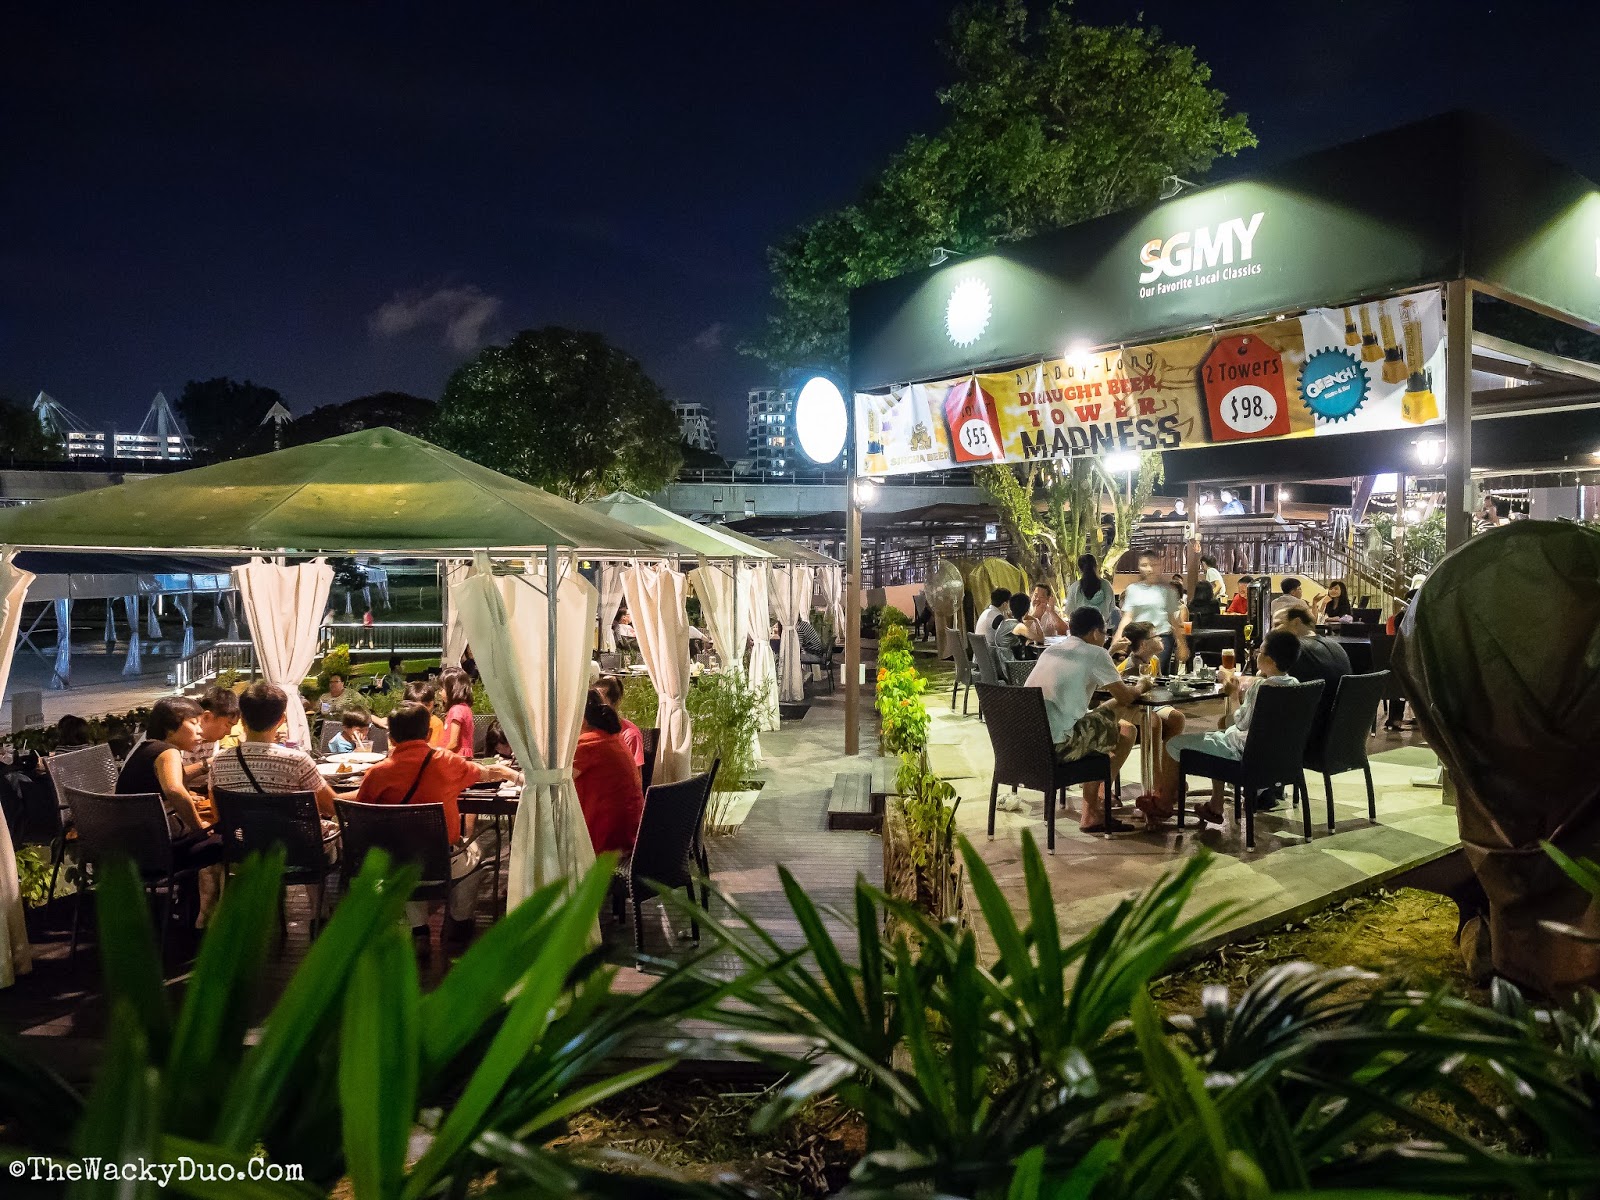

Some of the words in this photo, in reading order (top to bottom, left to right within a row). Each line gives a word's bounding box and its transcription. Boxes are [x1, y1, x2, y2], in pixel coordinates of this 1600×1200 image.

[1139, 212, 1265, 284] SGMY
[1140, 286, 1155, 299] Our
[1157, 278, 1193, 295] Favorite
[1195, 269, 1220, 287] Local
[1222, 263, 1262, 281] Classics
[1206, 364, 1214, 384] 2
[1219, 358, 1279, 381] Towers
[1018, 383, 1103, 407] DRAUGHT
[1107, 374, 1158, 395] BEER
[1027, 397, 1157, 427] TOWER
[1020, 415, 1182, 459] MADNESS
